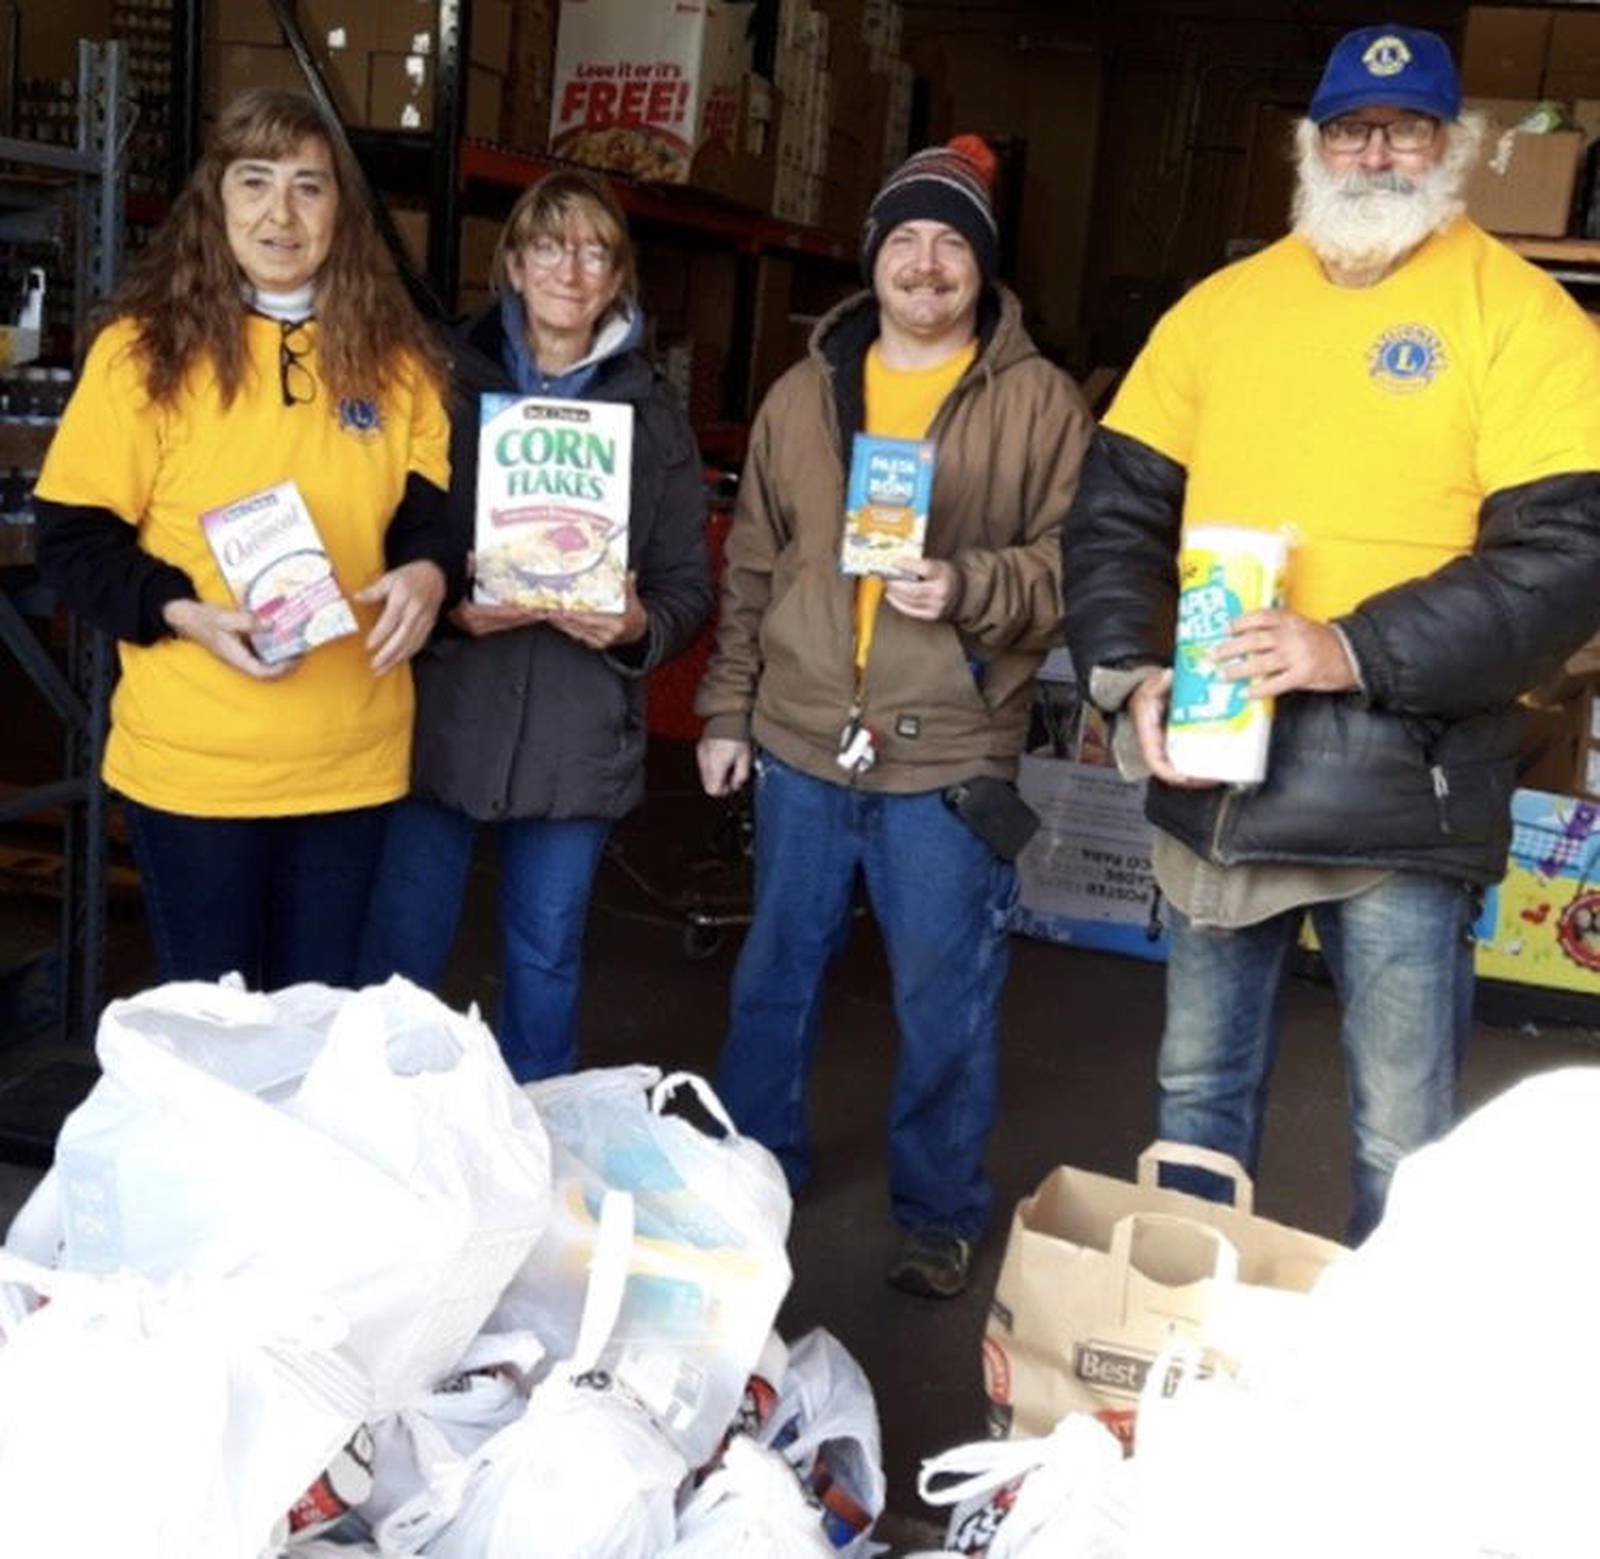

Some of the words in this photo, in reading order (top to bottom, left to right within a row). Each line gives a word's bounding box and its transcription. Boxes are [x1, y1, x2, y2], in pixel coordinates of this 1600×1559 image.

[618, 60, 632, 77] it
[635, 65, 653, 77] or
[655, 62, 683, 77] it's
[560, 81, 690, 129] FREE!
[1396, 344, 1416, 370] L
[495, 427, 616, 475] CORN
[507, 469, 605, 501] FLAKES
[1082, 1351, 1138, 1388] Best
